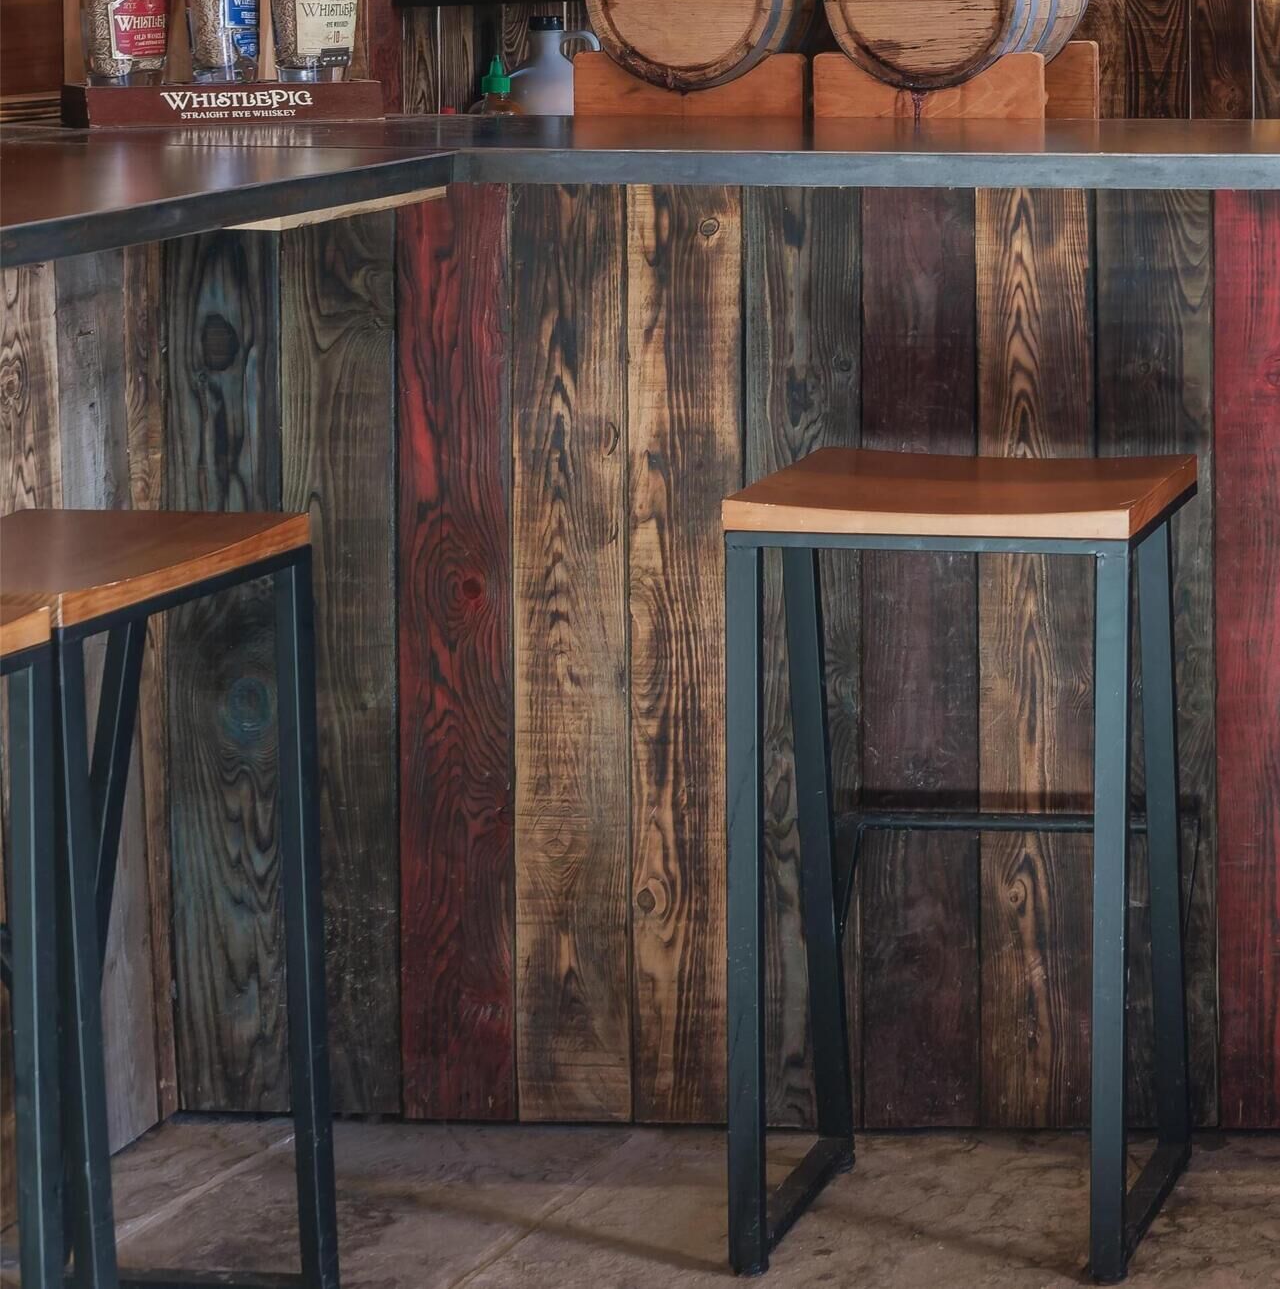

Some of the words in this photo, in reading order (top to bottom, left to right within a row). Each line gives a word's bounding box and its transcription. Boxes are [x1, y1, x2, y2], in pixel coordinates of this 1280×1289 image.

[160, 89, 313, 111] WHISTLEPIG
[180, 111, 230, 120] STRAIGHT
[232, 110, 251, 118] RYE
[252, 109, 296, 118] WHISKEY
